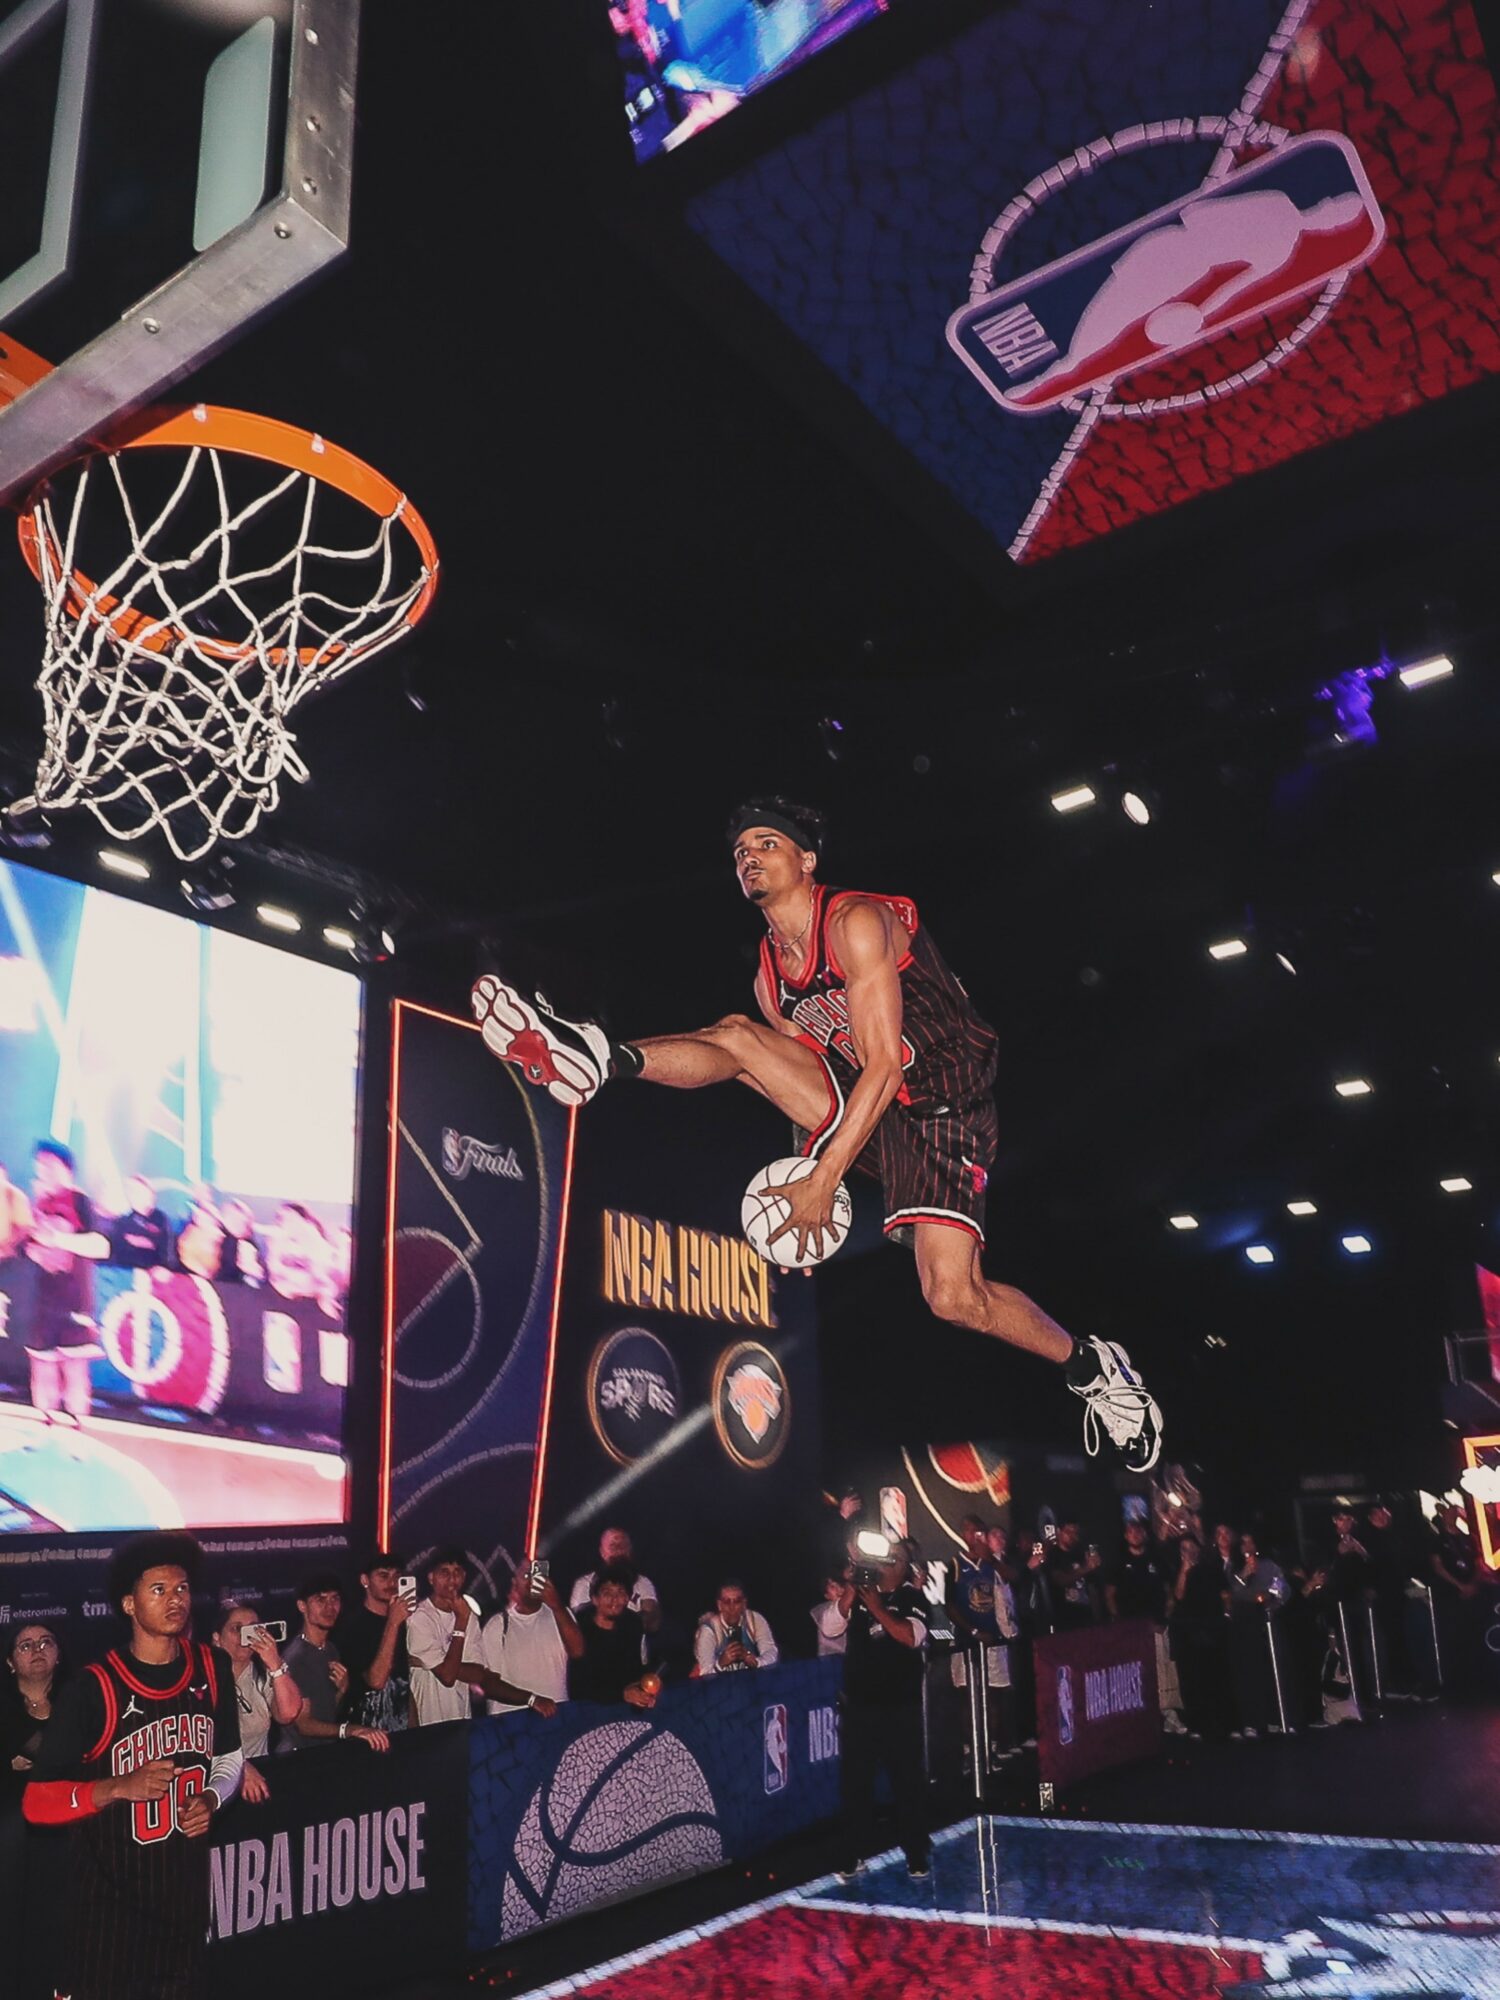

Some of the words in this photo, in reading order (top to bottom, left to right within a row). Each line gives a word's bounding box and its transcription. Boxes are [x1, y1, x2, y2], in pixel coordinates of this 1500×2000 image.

[972, 302, 1058, 376] NBA
[603, 1209, 676, 1312] NBA
[210, 1831, 292, 1939] NBA
[302, 1801, 426, 1916] HOUSE
